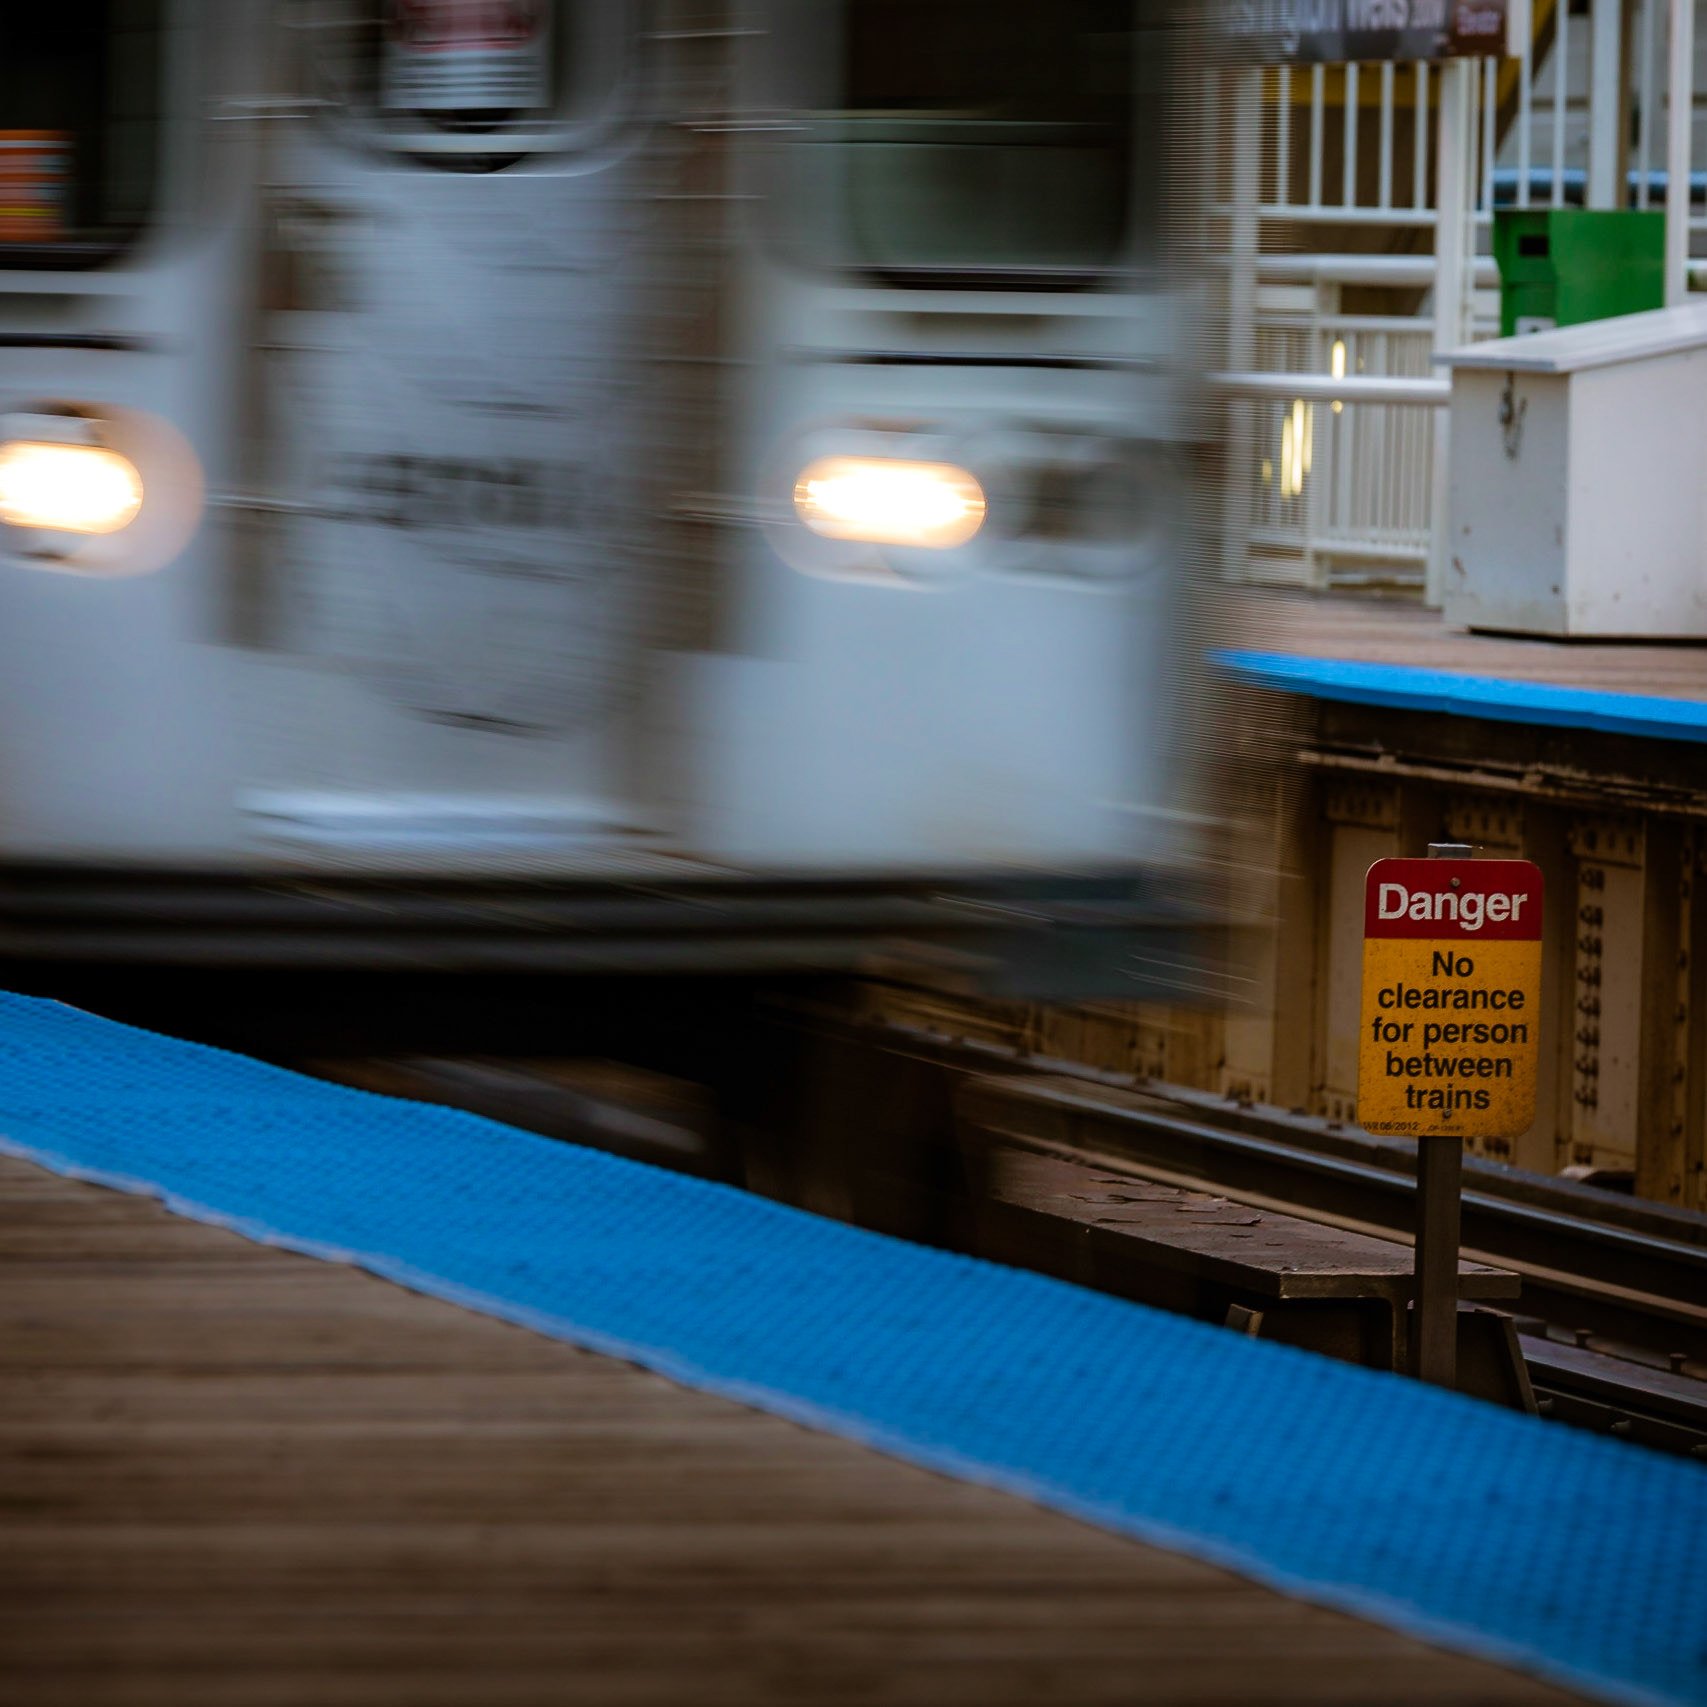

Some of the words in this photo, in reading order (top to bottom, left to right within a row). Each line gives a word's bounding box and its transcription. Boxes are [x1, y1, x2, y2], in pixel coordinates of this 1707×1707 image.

[1378, 883, 1528, 931] Danger
[1432, 951, 1475, 977] No
[1377, 983, 1525, 1010] clearance
[1372, 1016, 1414, 1043] for
[1423, 1021, 1528, 1049] person
[1386, 1051, 1513, 1078] between
[1405, 1084, 1491, 1110] trains
